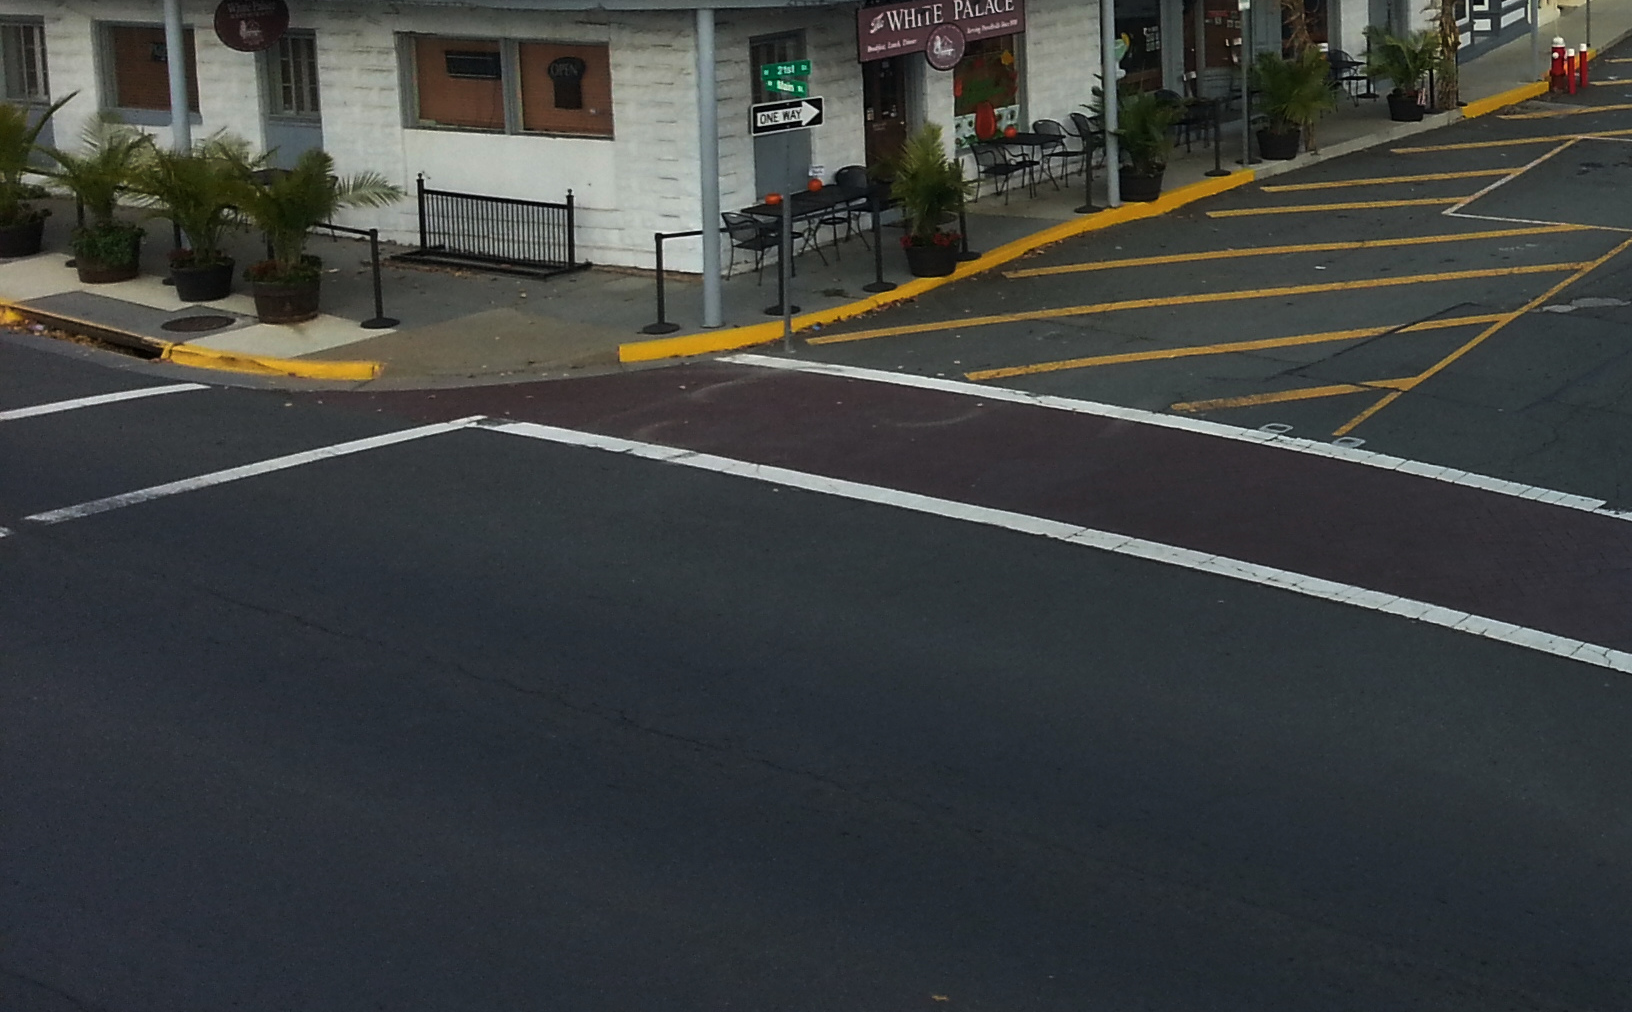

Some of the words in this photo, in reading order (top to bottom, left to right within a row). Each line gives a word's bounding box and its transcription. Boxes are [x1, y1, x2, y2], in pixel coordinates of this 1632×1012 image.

[886, 3, 944, 31] WHITE
[550, 62, 579, 78] OPEN
[777, 64, 796, 75] 21st
[760, 111, 779, 125] ONE
[781, 107, 802, 121] WAY
